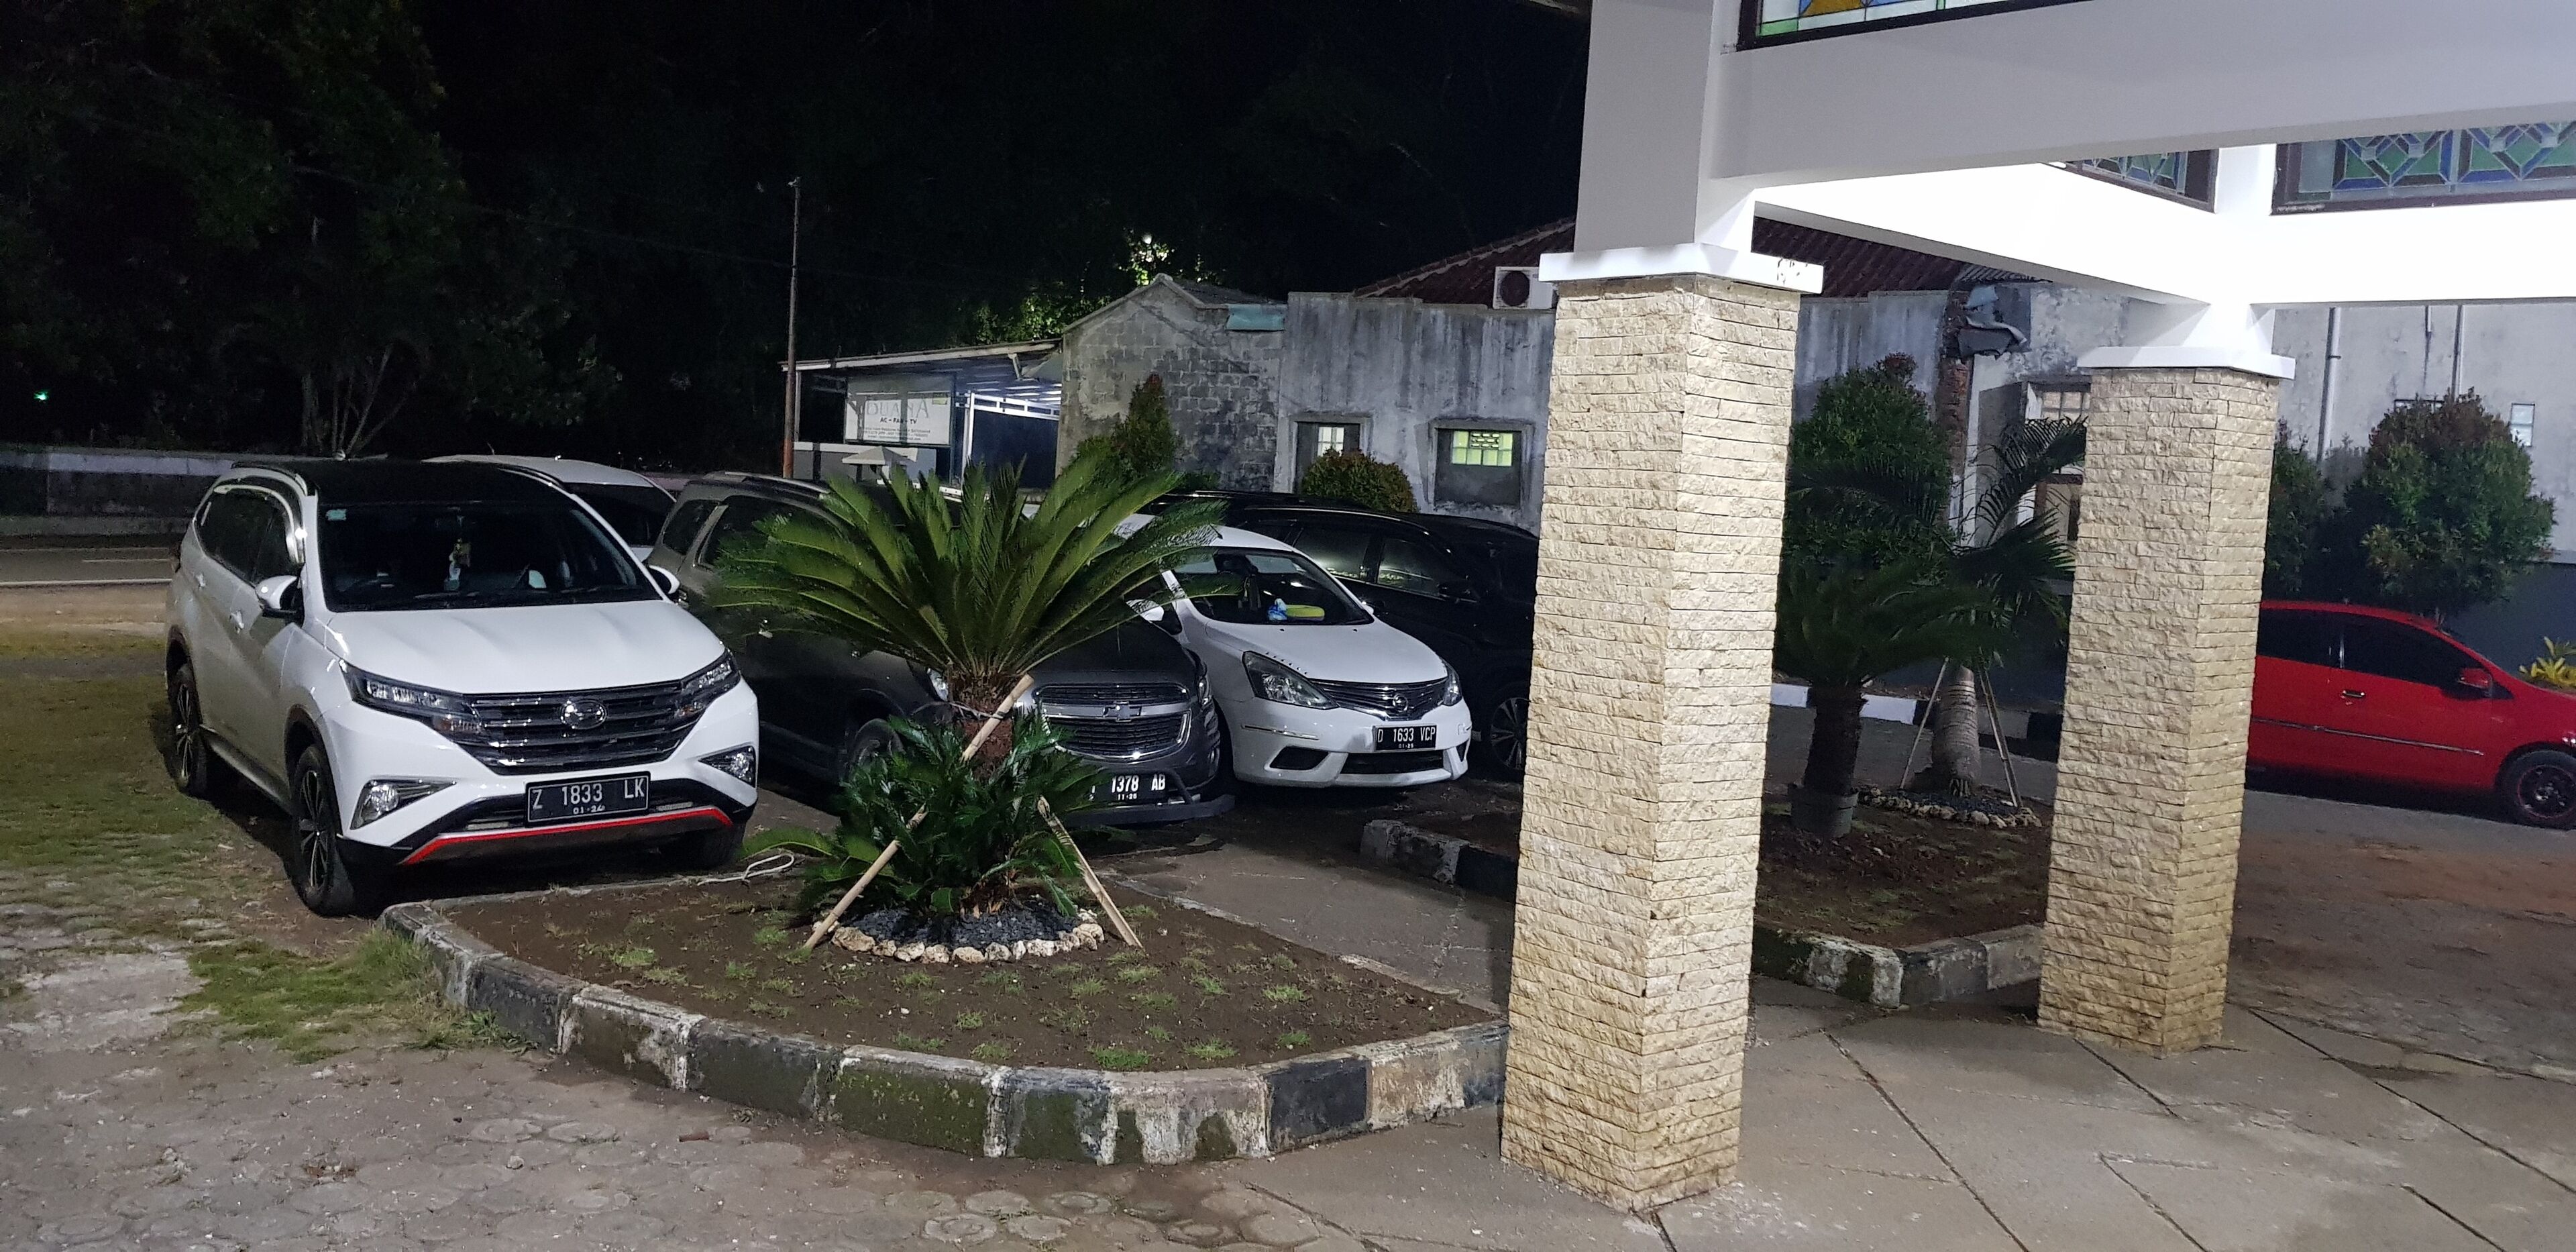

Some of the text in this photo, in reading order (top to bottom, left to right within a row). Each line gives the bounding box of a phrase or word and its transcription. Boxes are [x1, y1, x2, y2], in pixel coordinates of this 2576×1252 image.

[1377, 727, 1436, 743] D 1633 VCP
[1111, 775, 1139, 793] 1378
[1151, 774, 1166, 791] AB
[532, 778, 645, 811] Z 1833 LK
